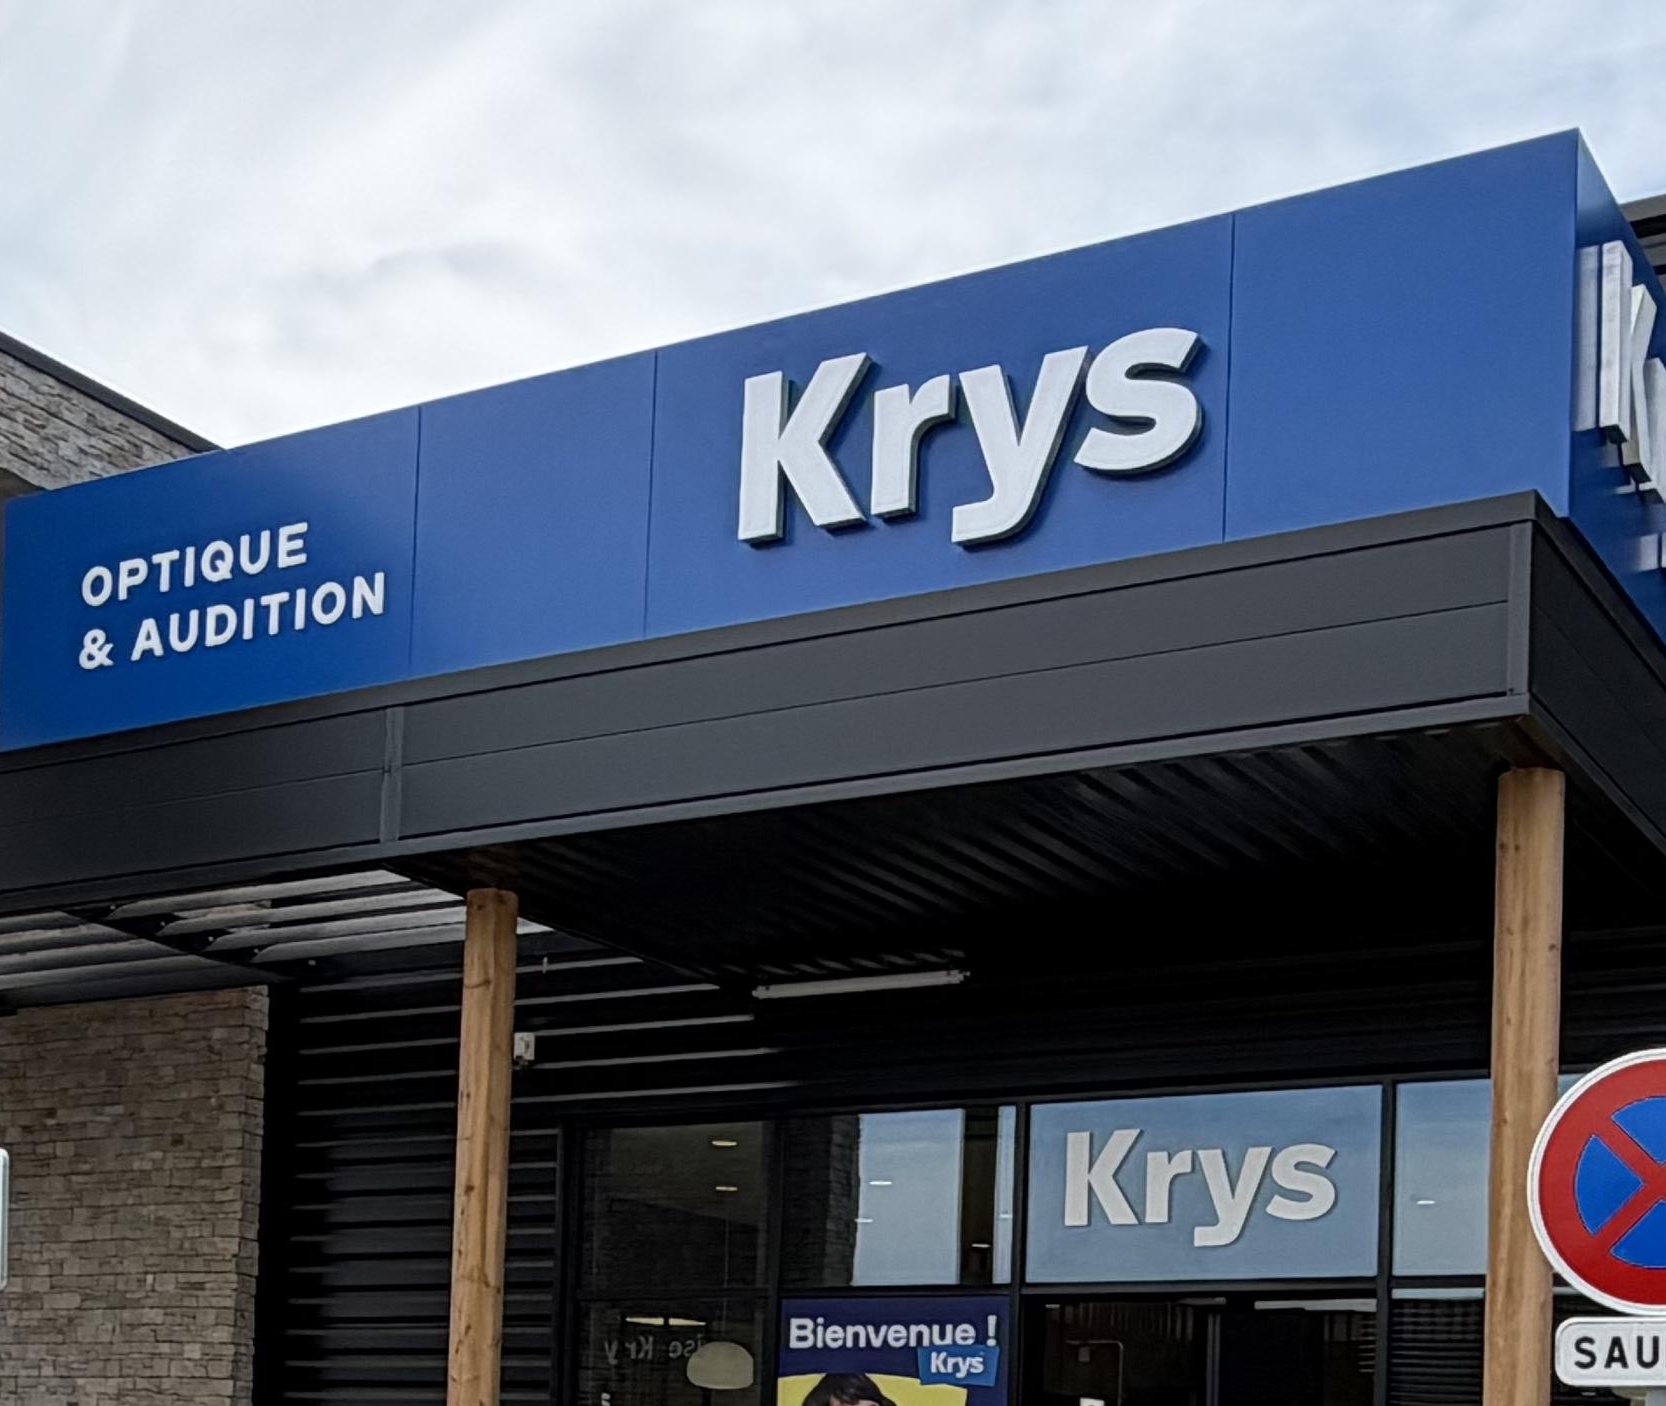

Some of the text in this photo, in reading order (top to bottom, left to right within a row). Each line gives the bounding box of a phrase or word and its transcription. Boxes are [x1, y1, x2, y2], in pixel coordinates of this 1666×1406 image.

[738, 327, 1204, 546] Krys
[81, 522, 309, 607] OPTIQUE
[78, 571, 386, 670] & AUDITION
[1064, 1128, 1336, 1247] Krys
[789, 1314, 997, 1349] Bienvenue !
[930, 1351, 984, 1379] Krys
